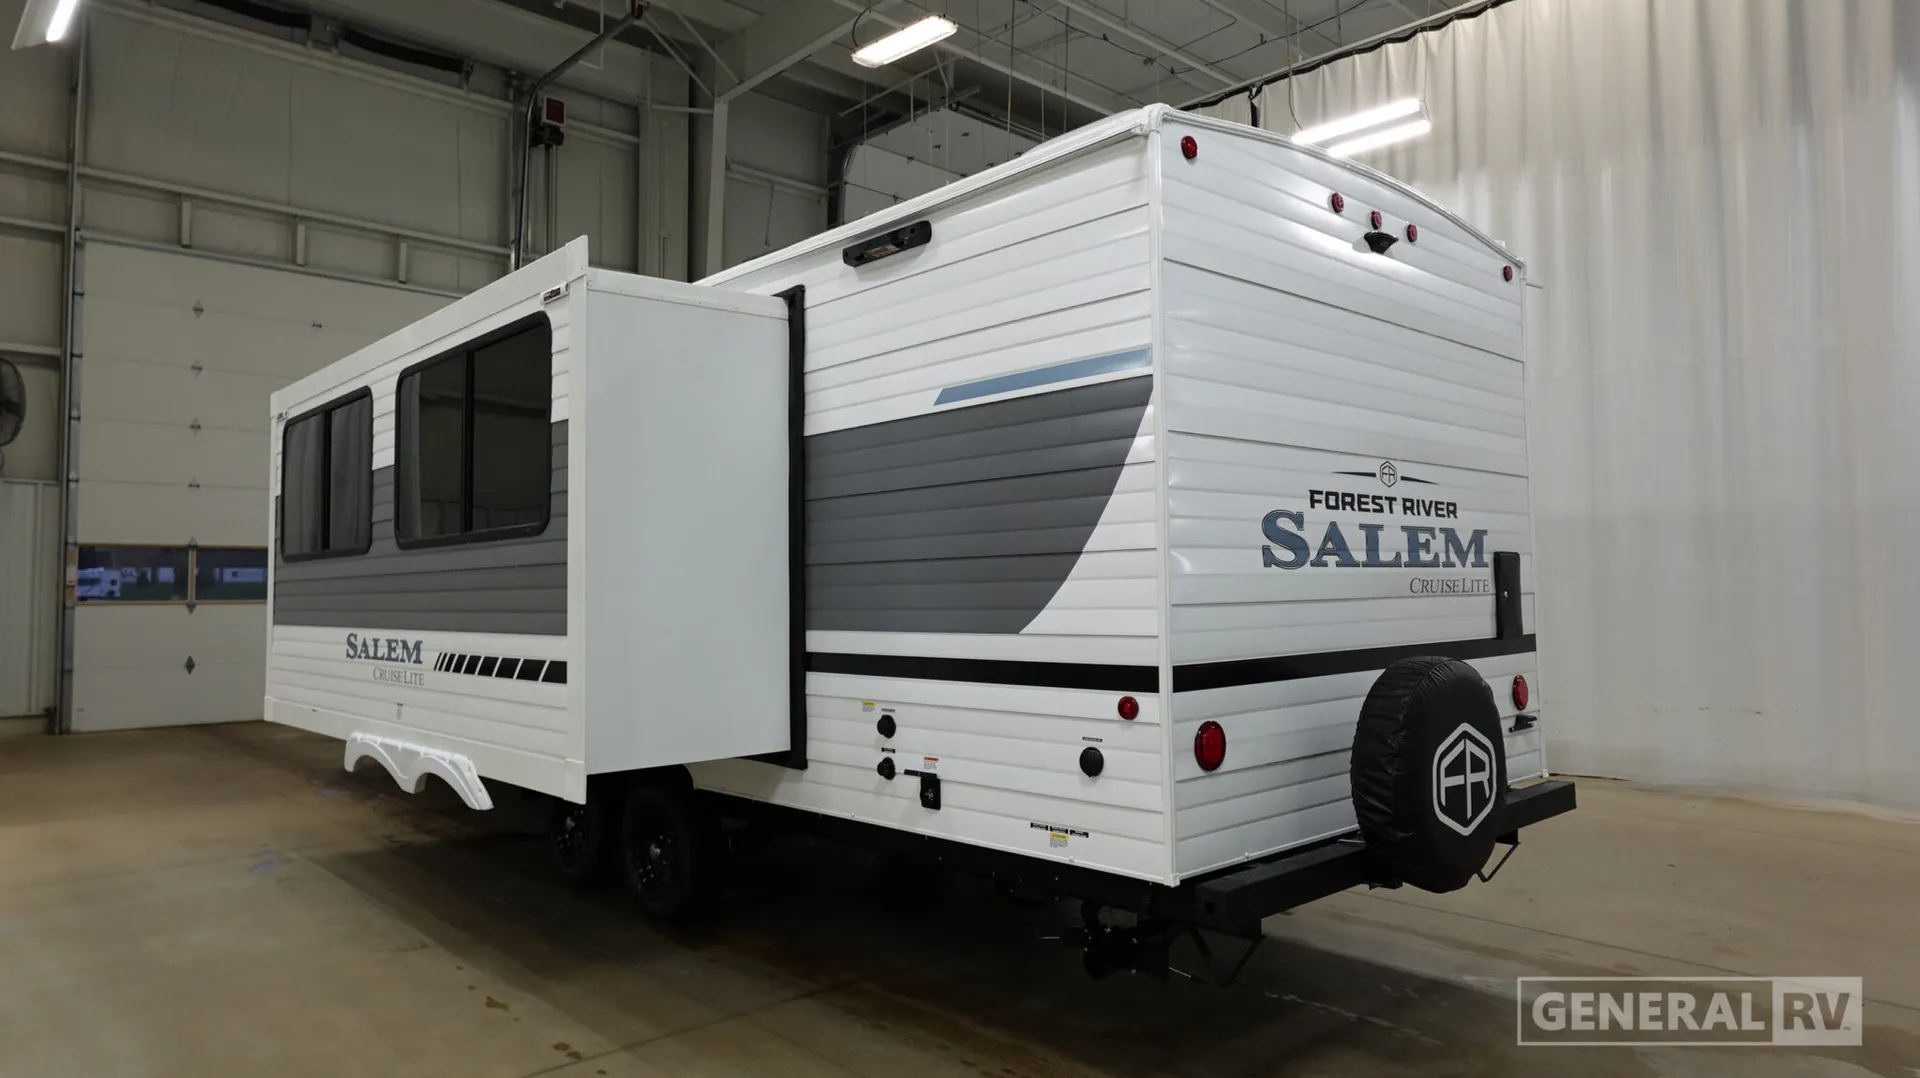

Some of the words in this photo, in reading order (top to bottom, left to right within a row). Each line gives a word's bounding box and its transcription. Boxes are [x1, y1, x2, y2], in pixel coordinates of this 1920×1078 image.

[1308, 489, 1398, 514] FOREST
[1402, 497, 1458, 519] RIVER
[1261, 509, 1489, 569] SALEM
[346, 633, 423, 664] SALEM
[1440, 738, 1490, 820] FR
